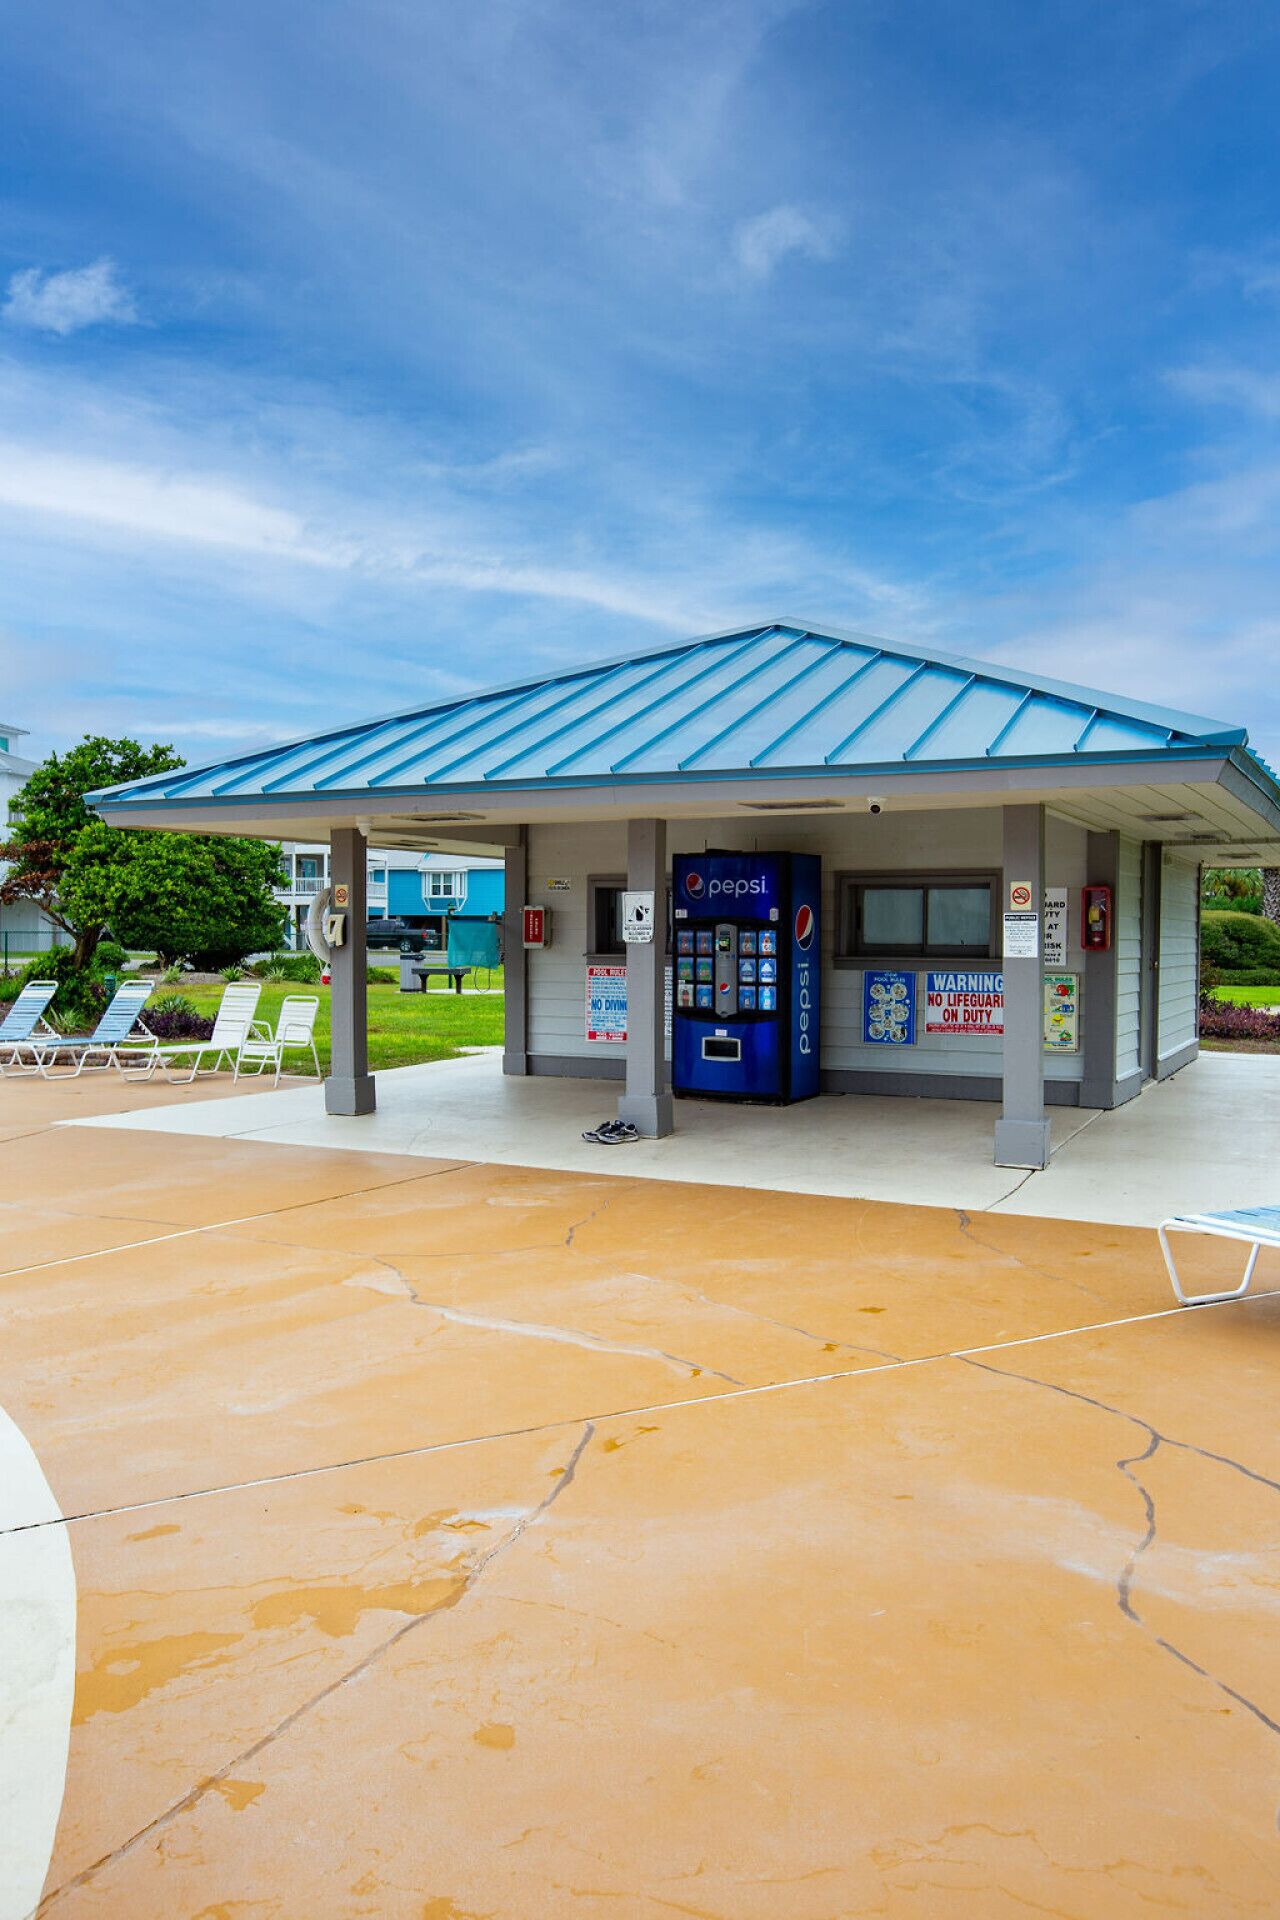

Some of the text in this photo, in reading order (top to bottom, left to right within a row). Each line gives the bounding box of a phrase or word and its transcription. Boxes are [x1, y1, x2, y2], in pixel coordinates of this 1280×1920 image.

[708, 875, 766, 898] pepsi
[934, 975, 1003, 991] WARNING
[591, 999, 627, 1010] NO DIVIN
[928, 993, 943, 1006] NO
[797, 962, 811, 1054] pepsi
[943, 1009, 992, 1023] ON DUTY
